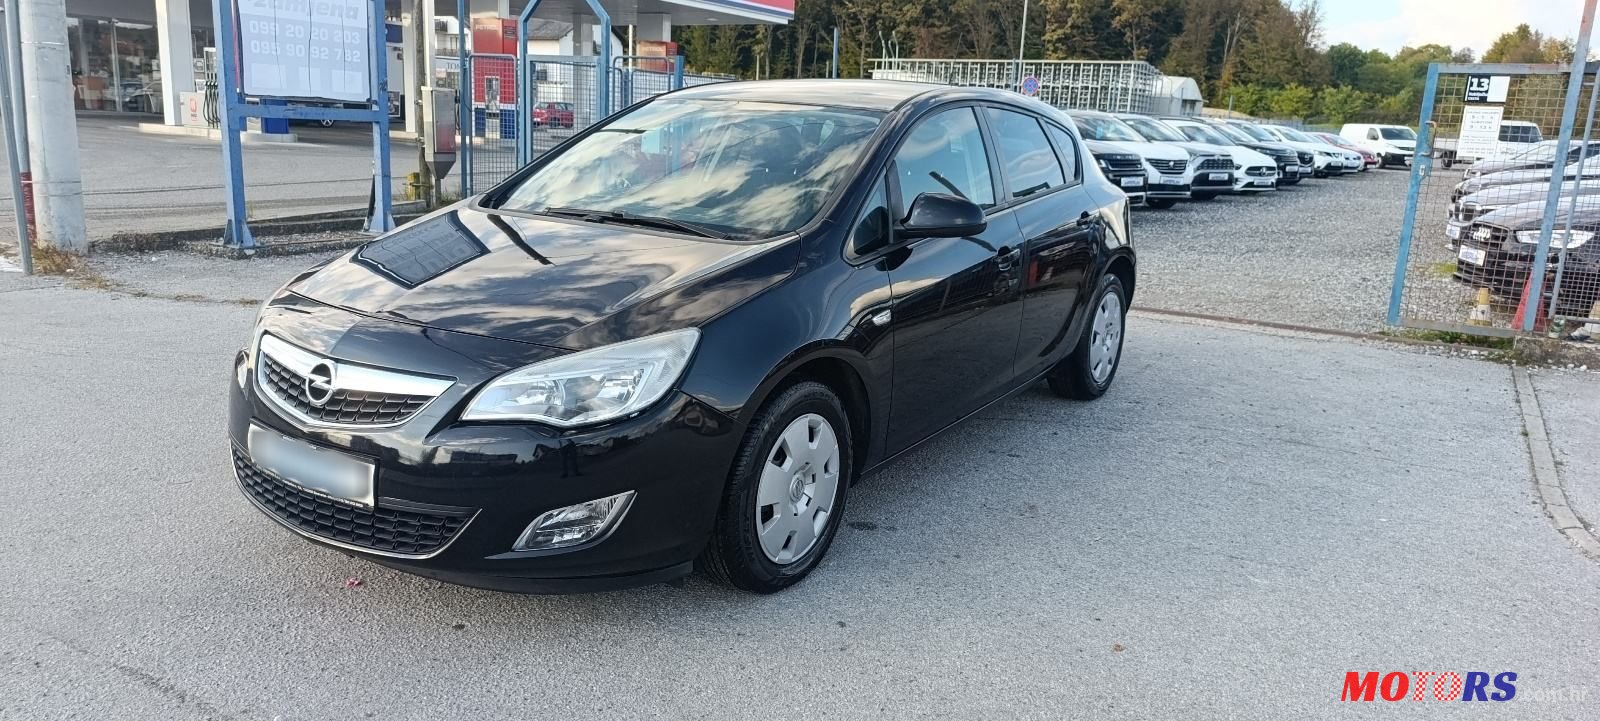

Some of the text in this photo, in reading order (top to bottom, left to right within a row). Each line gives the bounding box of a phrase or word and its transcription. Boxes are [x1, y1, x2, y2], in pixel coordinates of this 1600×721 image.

[254, 0, 359, 19] amena
[249, 20, 361, 44] 099 20 20 203
[250, 40, 281, 55] 095
[286, 43, 305, 57] 90
[311, 46, 329, 59] 92
[1469, 77, 1490, 91] 13
